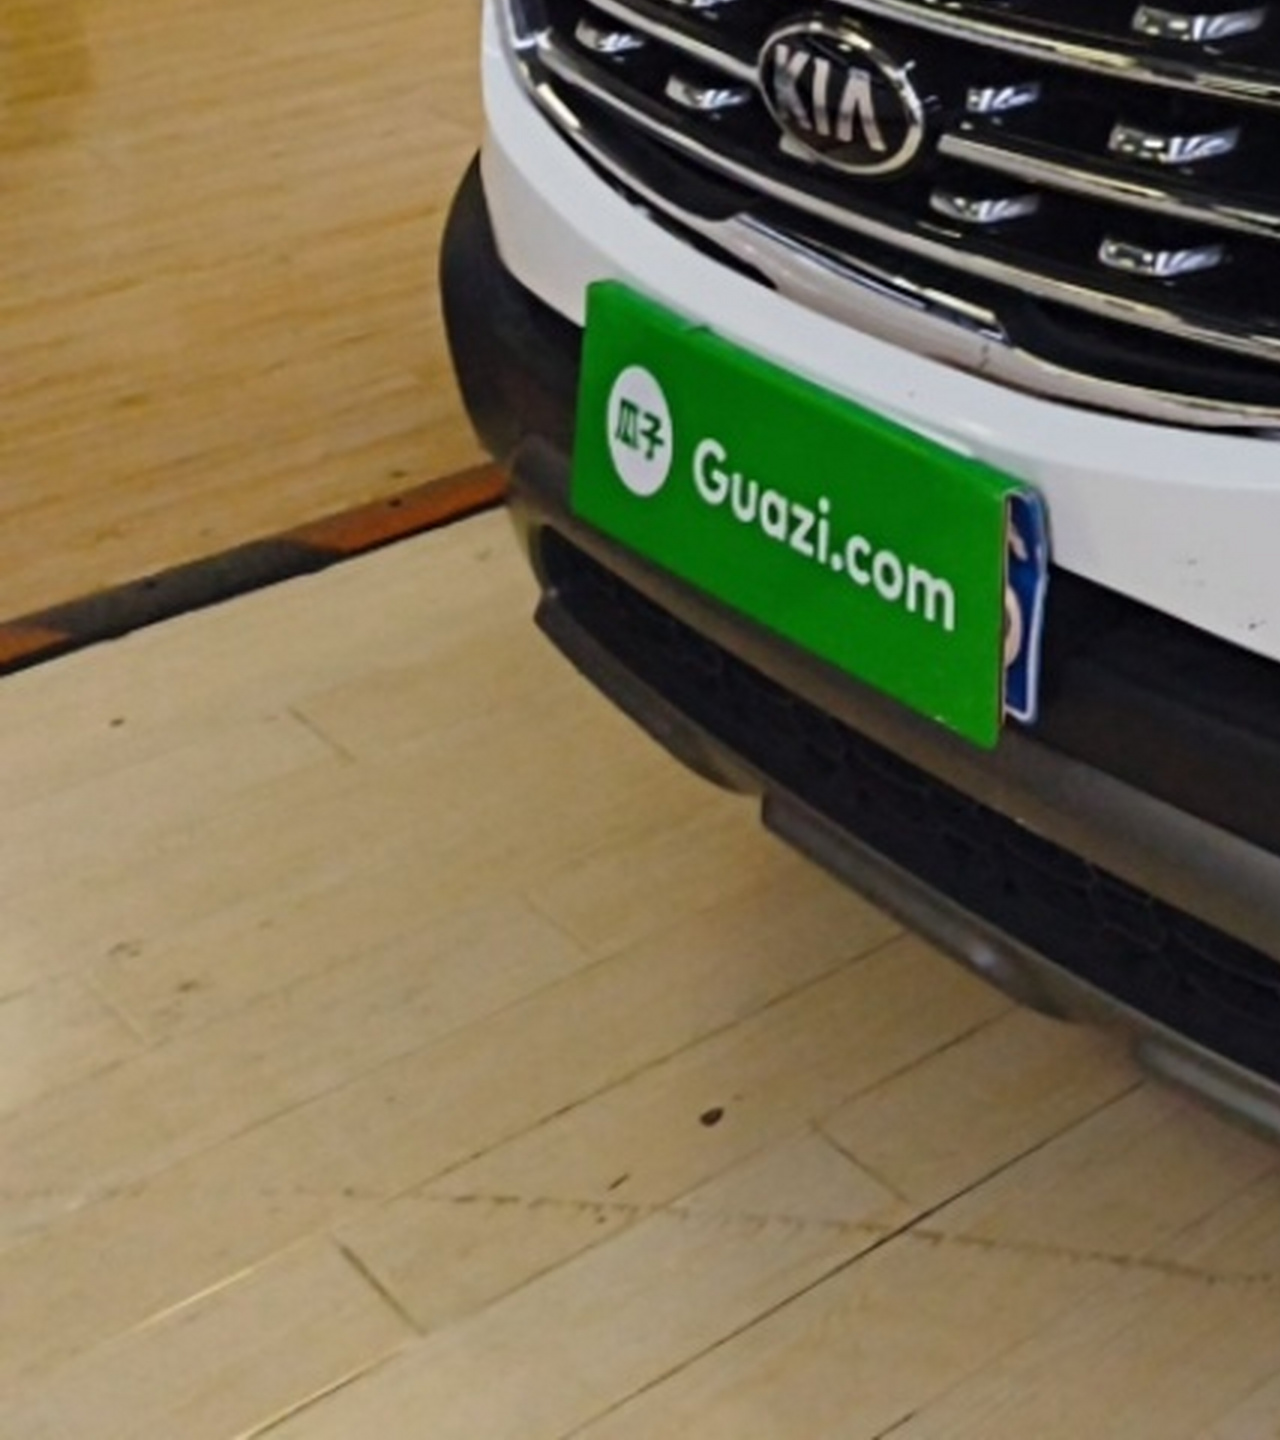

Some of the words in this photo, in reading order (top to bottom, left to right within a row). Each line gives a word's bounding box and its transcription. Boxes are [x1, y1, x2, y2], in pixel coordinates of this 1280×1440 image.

[774, 43, 887, 152] KIA
[615, 397, 665, 461] 瓜子
[692, 438, 956, 632] Guazi.com
